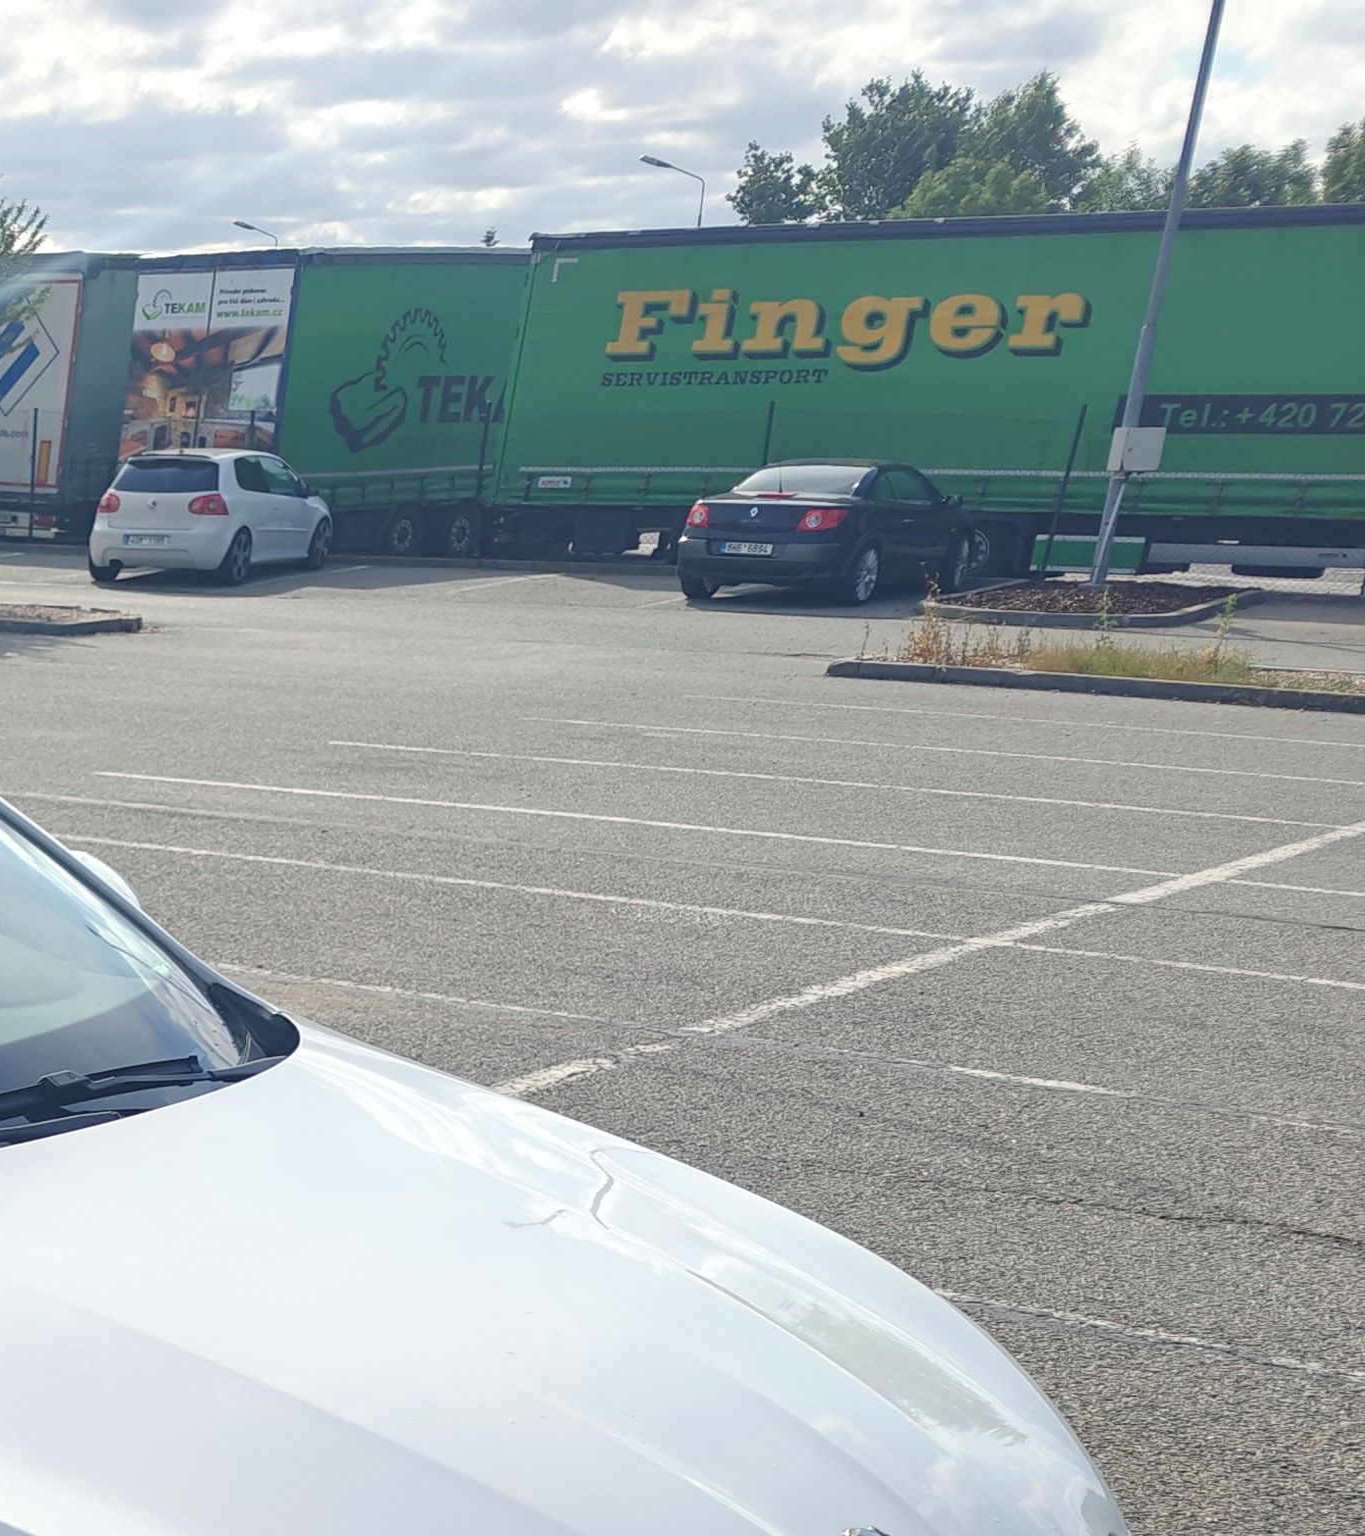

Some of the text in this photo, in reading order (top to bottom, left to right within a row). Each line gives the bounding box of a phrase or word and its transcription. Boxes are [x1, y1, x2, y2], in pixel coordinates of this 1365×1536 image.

[164, 301, 207, 315] TEKAM
[605, 288, 1092, 372] Finger
[600, 367, 829, 388] SERVISTRANSPORT
